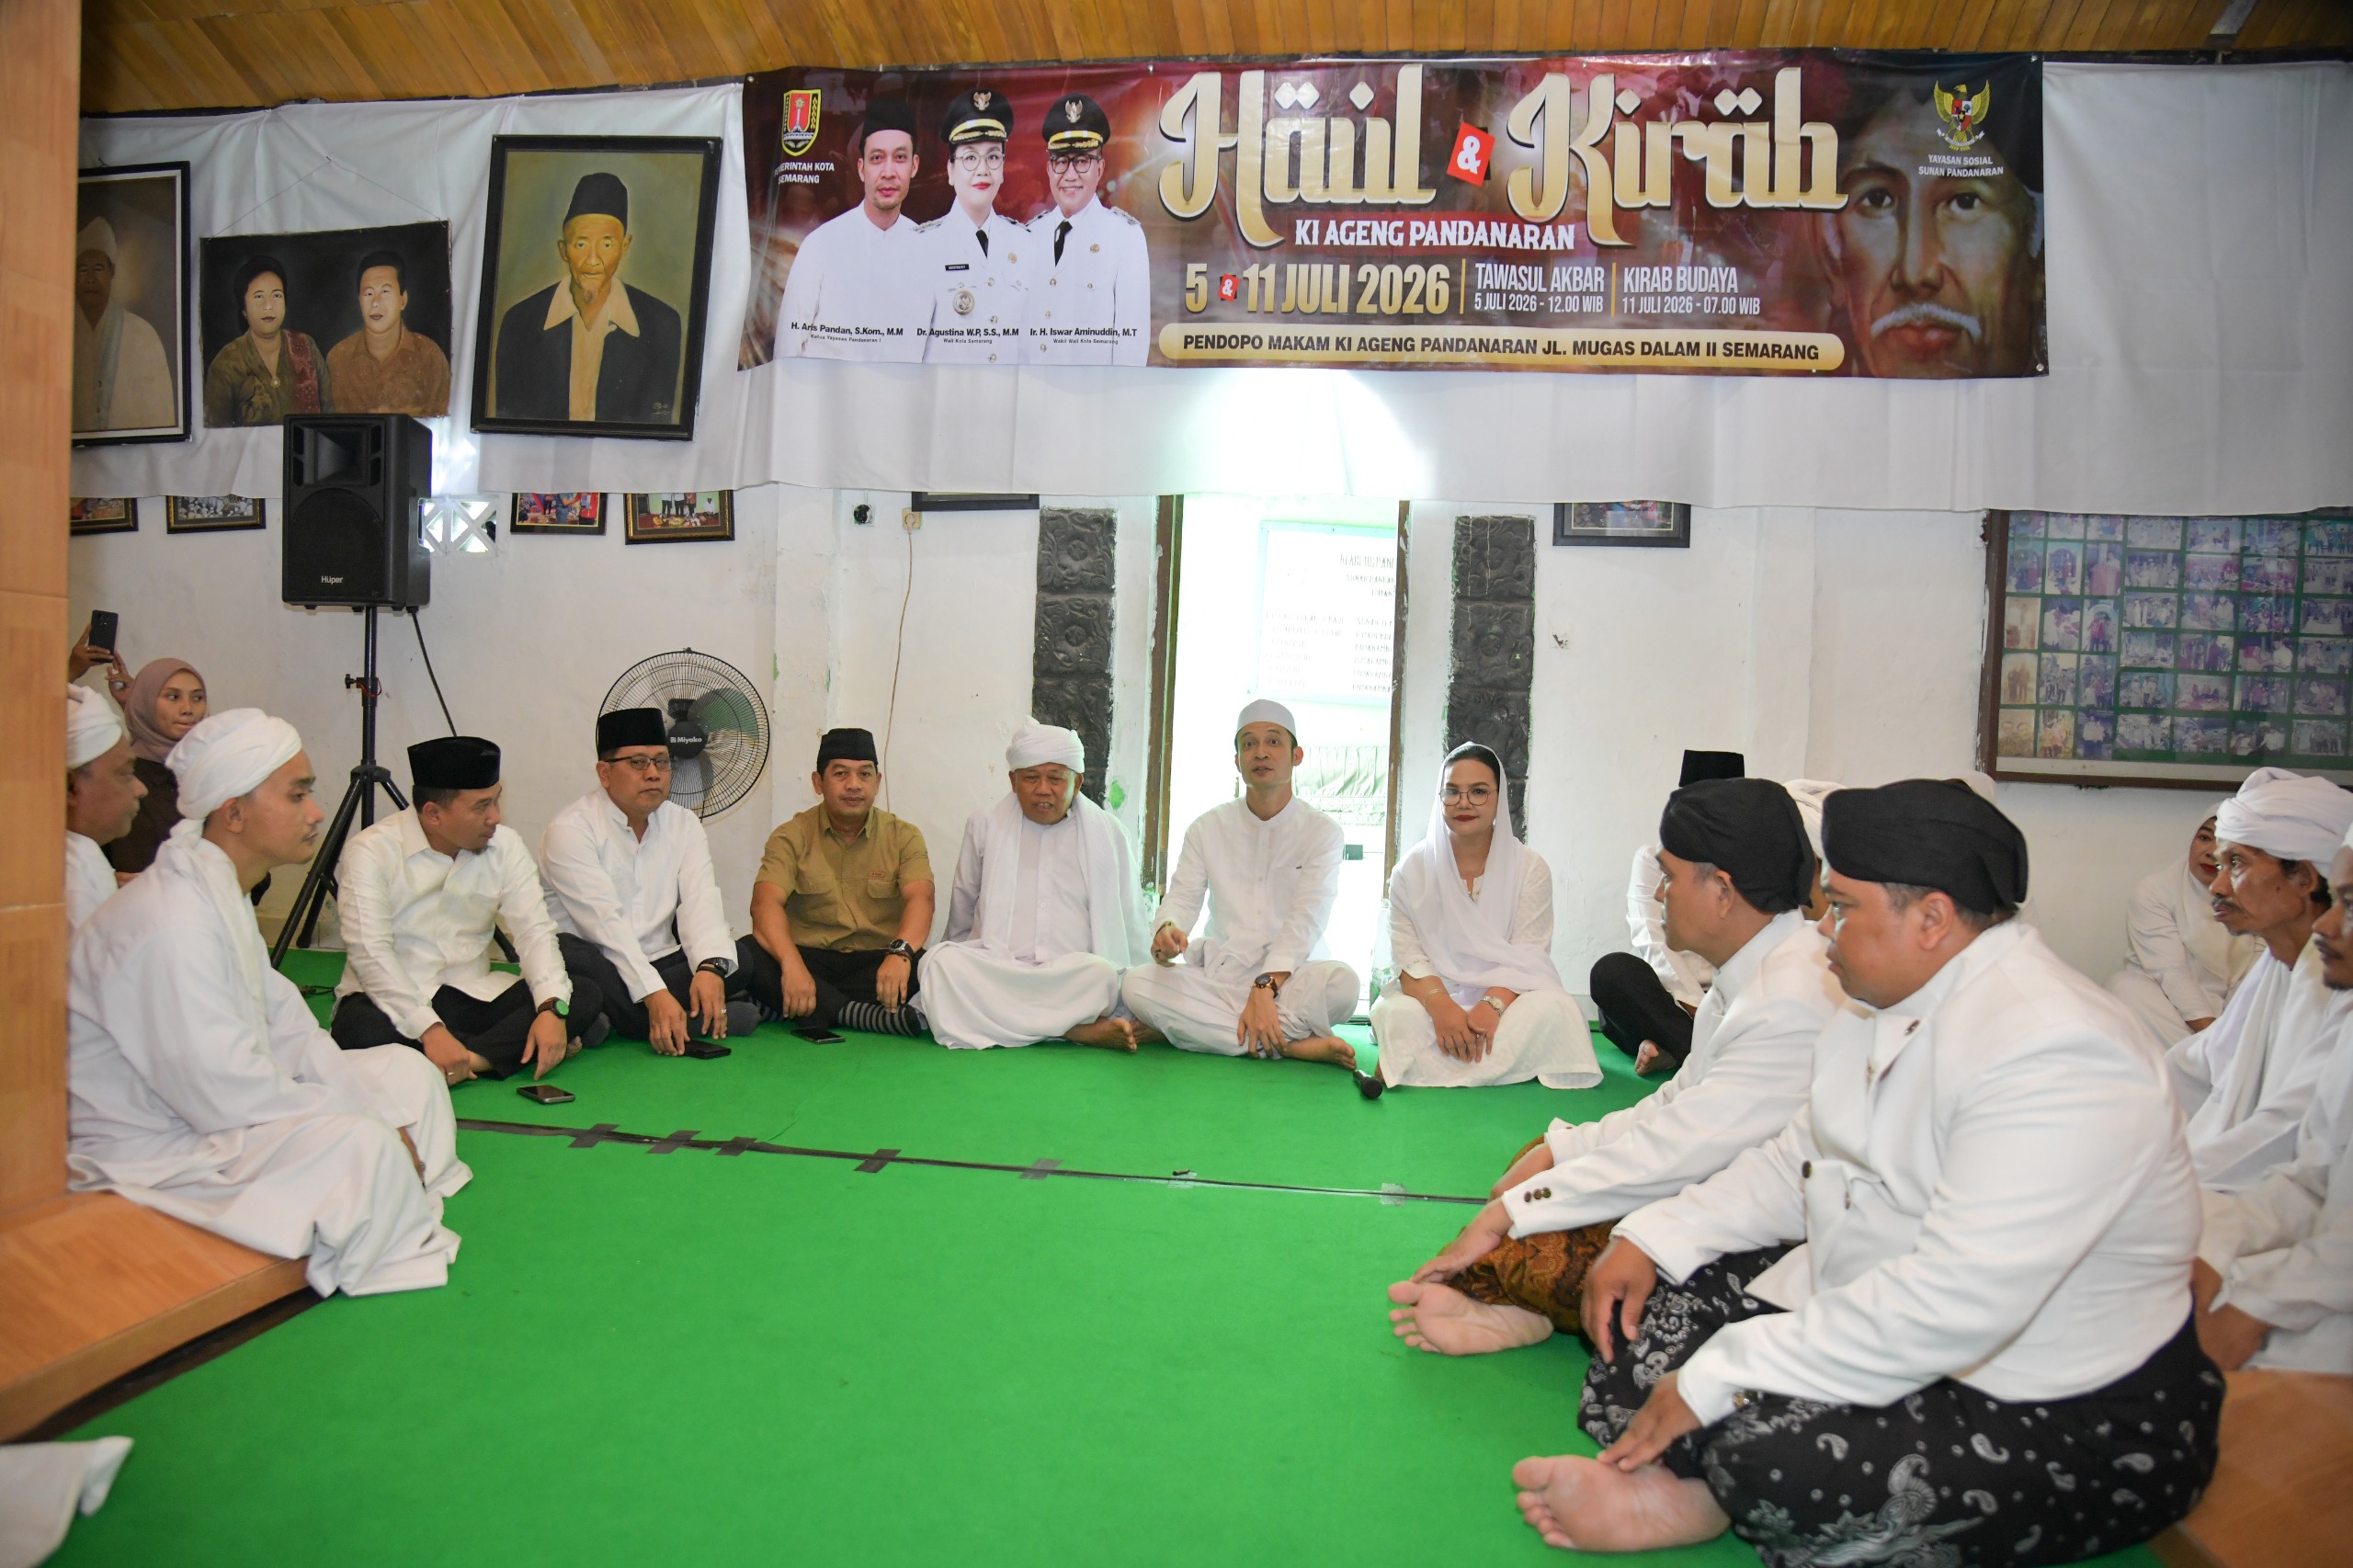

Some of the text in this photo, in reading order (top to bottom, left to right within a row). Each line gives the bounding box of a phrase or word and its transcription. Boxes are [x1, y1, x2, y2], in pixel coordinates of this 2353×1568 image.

[1928, 154, 1993, 165] YAYASAN SOSIAL
[814, 162, 835, 172] KOTA
[1918, 166, 2004, 177] SUNAN PANDANARAN
[779, 174, 820, 184] SEMARANG
[1295, 219, 1574, 250] KI AGENG PANDANARAN
[1475, 263, 1605, 292] TAWASUL AKBAR
[1623, 267, 1738, 293] KIRAB BUDAYA
[1185, 263, 1208, 312] 5
[1243, 263, 1277, 312] 11
[1281, 264, 1350, 313] JULI
[1356, 263, 1450, 314] 2026
[1474, 293, 1482, 311] 5
[1484, 293, 1506, 311] JULI
[1508, 294, 1537, 312] 2026
[1548, 295, 1580, 313] 12.00
[1582, 296, 1604, 313] WIB
[1622, 297, 1635, 314] 11
[1638, 296, 1661, 314] JULI
[1664, 296, 1693, 314] 2026
[1703, 297, 1736, 315] 07.00
[1739, 297, 1761, 315] WIB
[790, 322, 904, 336] H. Aris Pandan, S.Kom., M.M
[916, 328, 927, 336] Dr.
[929, 328, 964, 338] Agustina
[983, 328, 1001, 337] S.S.,
[1002, 328, 1019, 336] M.M
[1029, 327, 1138, 338] Ir. H. Iswar Aminuddin, M.T
[1183, 335, 1820, 360] PENDOPO MAKAM KI AGENG PANDANARAN JL. MUGAS DALAM II SEMARANG
[676, 736, 702, 744] Miyako
